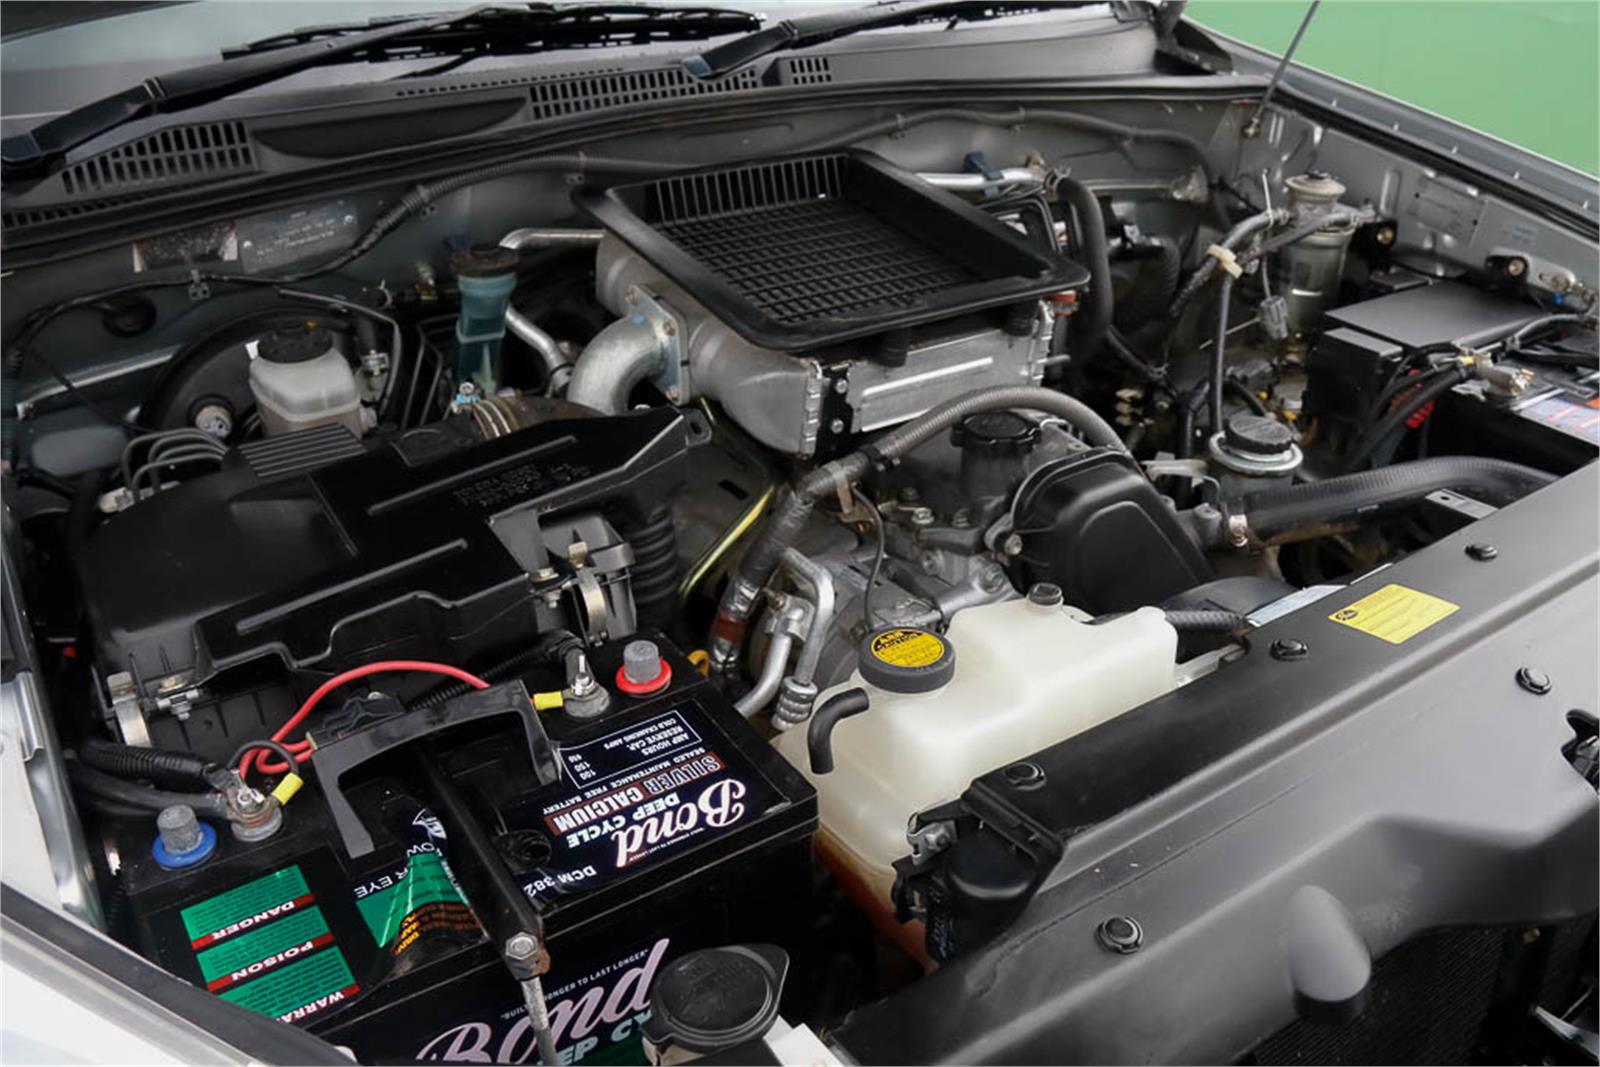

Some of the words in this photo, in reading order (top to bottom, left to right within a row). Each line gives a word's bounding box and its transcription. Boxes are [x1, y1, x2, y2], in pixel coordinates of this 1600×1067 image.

[603, 739, 623, 750] AMPS
[646, 725, 684, 743] RESERVE
[671, 732, 690, 745] AMP
[641, 740, 672, 756] HOURS
[672, 747, 706, 763] SEALED
[574, 761, 591, 773] 150
[610, 760, 672, 789] MAINTENANCE
[643, 755, 722, 795] SILVER
[584, 785, 609, 799] FREE
[543, 795, 583, 816] BATTERY
[553, 785, 644, 832] CALCIUM
[632, 792, 681, 821] DEEP
[566, 814, 626, 848] CYCLE
[610, 778, 746, 868] Bond
[557, 865, 597, 884] DCM
[354, 875, 394, 898] EYE
[523, 876, 556, 898] 382
[211, 901, 296, 940] DANGER
[231, 941, 315, 981] POISON
[577, 976, 588, 986] TO
[590, 965, 611, 981] LAST
[276, 991, 345, 1024] WARRA
[415, 938, 670, 1065] Bond
